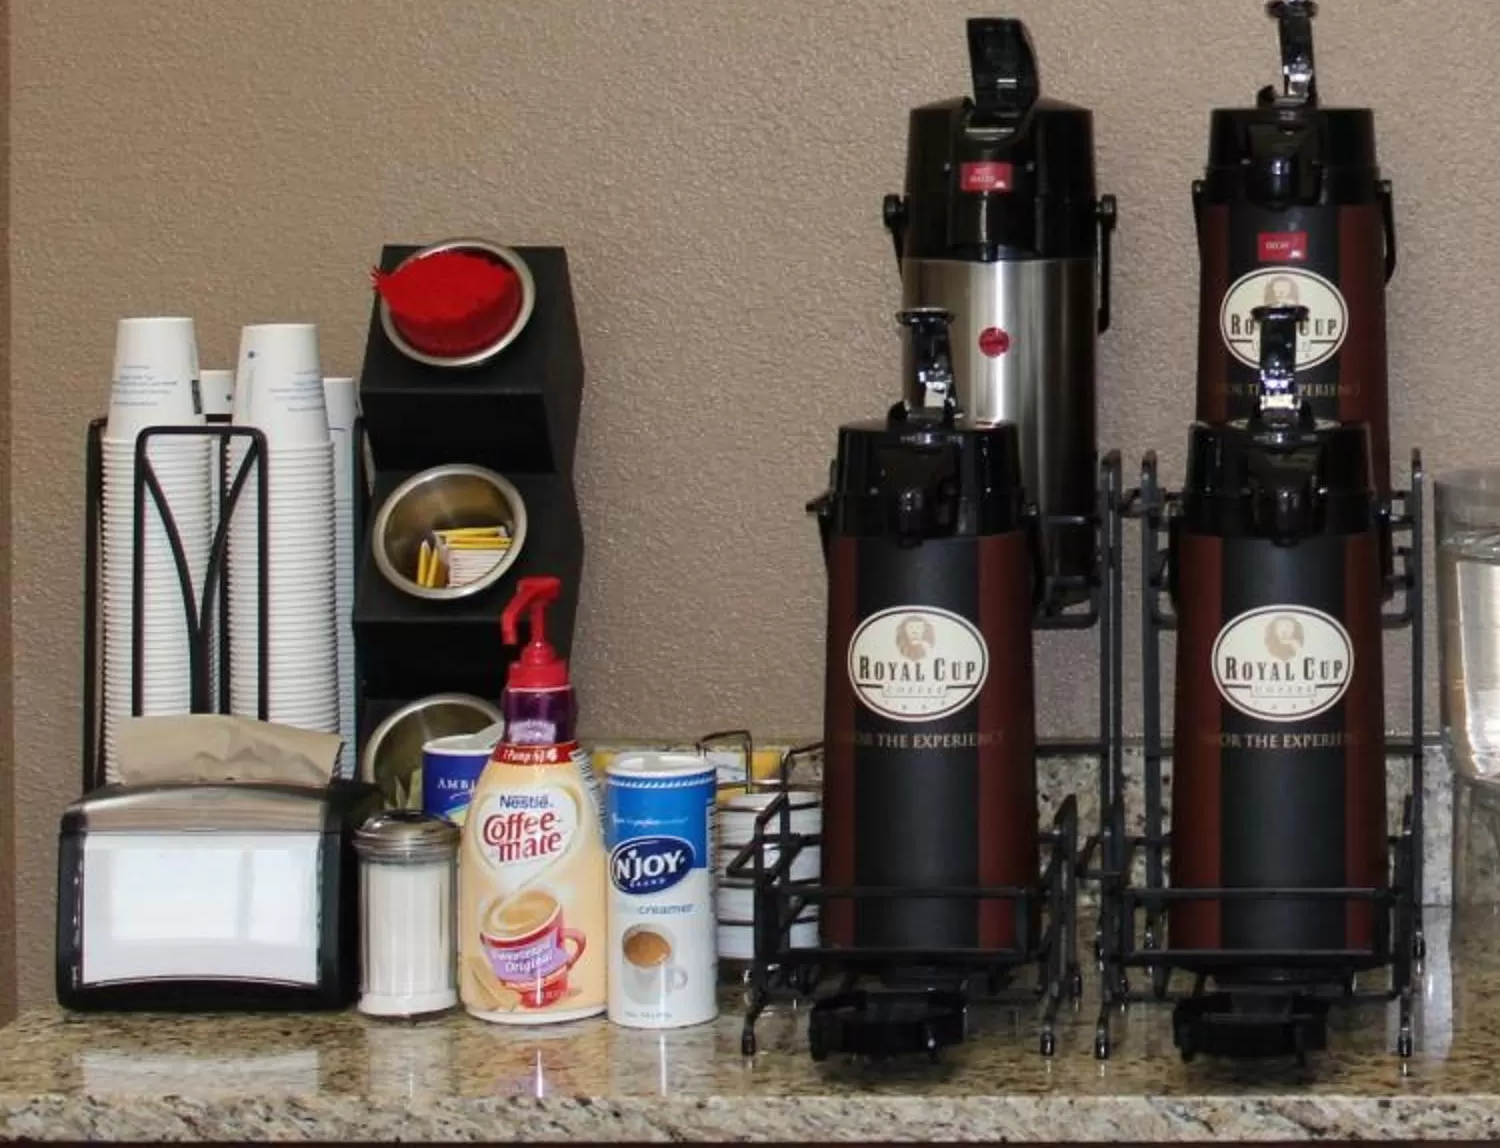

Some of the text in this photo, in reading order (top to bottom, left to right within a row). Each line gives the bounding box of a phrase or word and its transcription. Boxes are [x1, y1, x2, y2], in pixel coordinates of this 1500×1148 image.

[859, 655, 977, 683] ROYAL CUP
[1225, 656, 1344, 682] ROYAL CUP
[877, 732, 908, 749] THE
[1244, 732, 1280, 749] THE
[499, 831, 562, 863] mate
